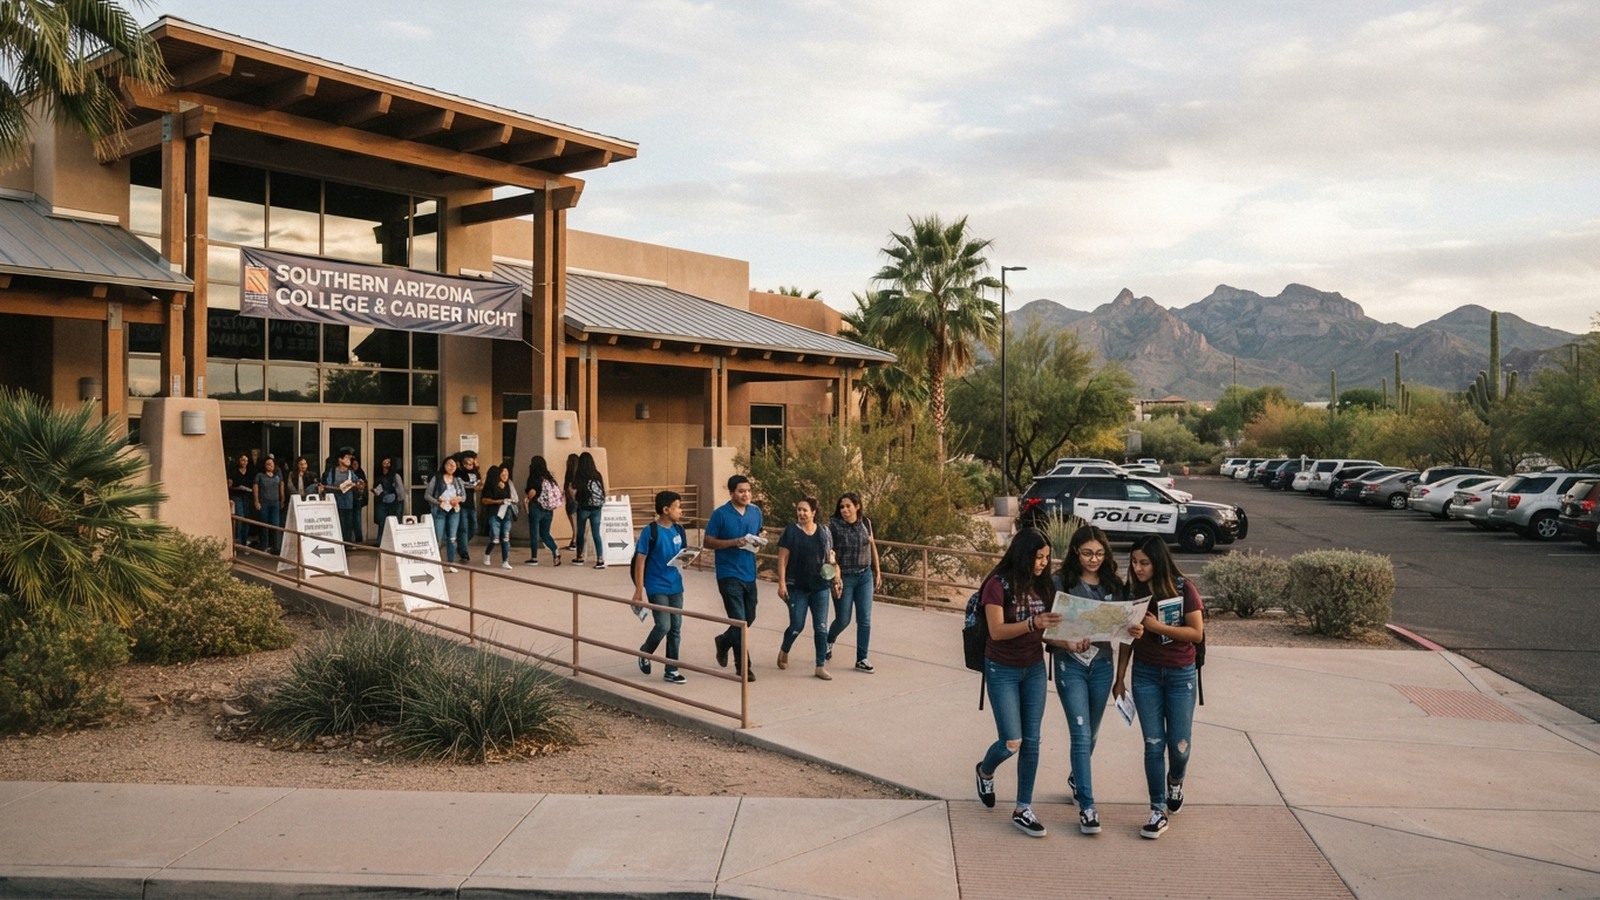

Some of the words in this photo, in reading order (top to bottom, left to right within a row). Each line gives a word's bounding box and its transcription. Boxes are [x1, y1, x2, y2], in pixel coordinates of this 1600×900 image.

[275, 264, 388, 294] SOUTHERN
[393, 278, 475, 305] ARIZONA
[275, 287, 370, 315] COLLEGE
[374, 299, 387, 316] &
[390, 299, 463, 323] CAREER
[1092, 511, 1173, 524] POLICE
